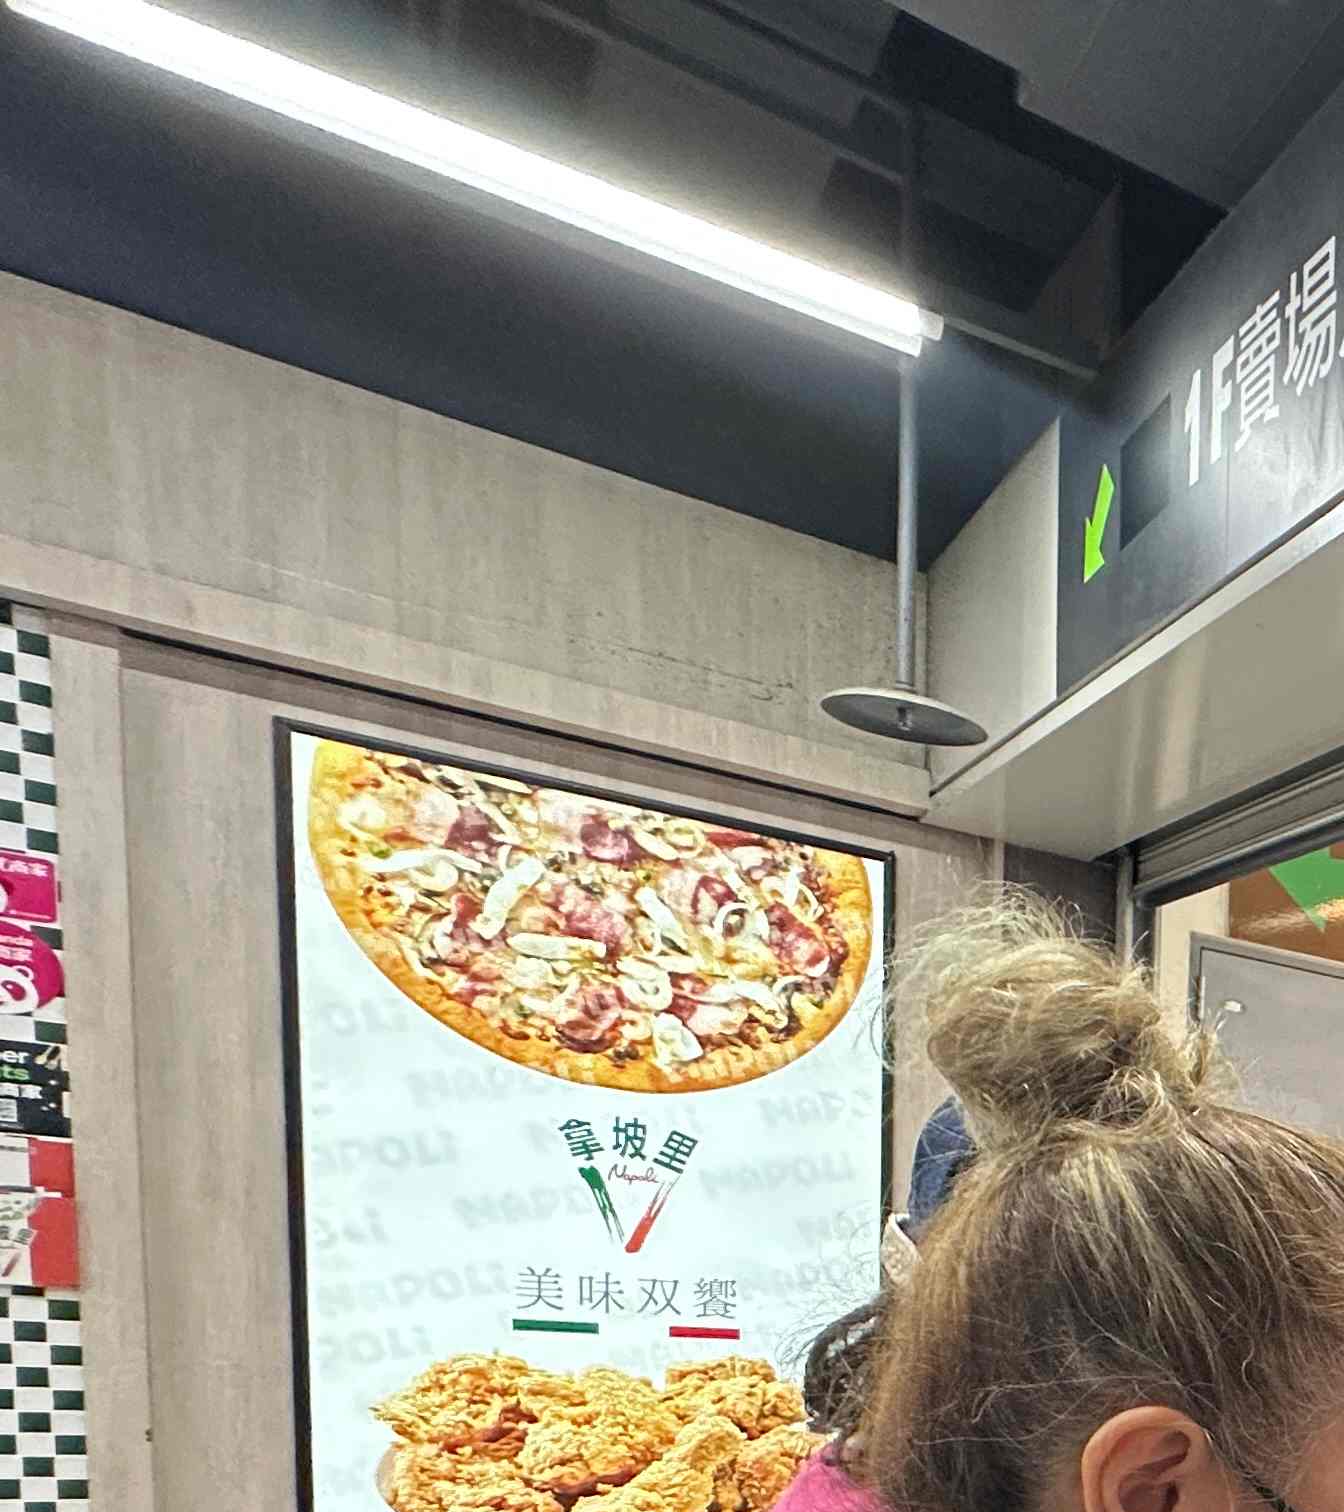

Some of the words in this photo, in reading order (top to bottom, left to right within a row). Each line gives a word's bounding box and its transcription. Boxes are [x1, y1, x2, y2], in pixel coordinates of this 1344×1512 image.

[558, 1116, 699, 1174] 拿坡里
[607, 1163, 660, 1186] Napoli
[512, 1265, 737, 1319] 美味双饗
